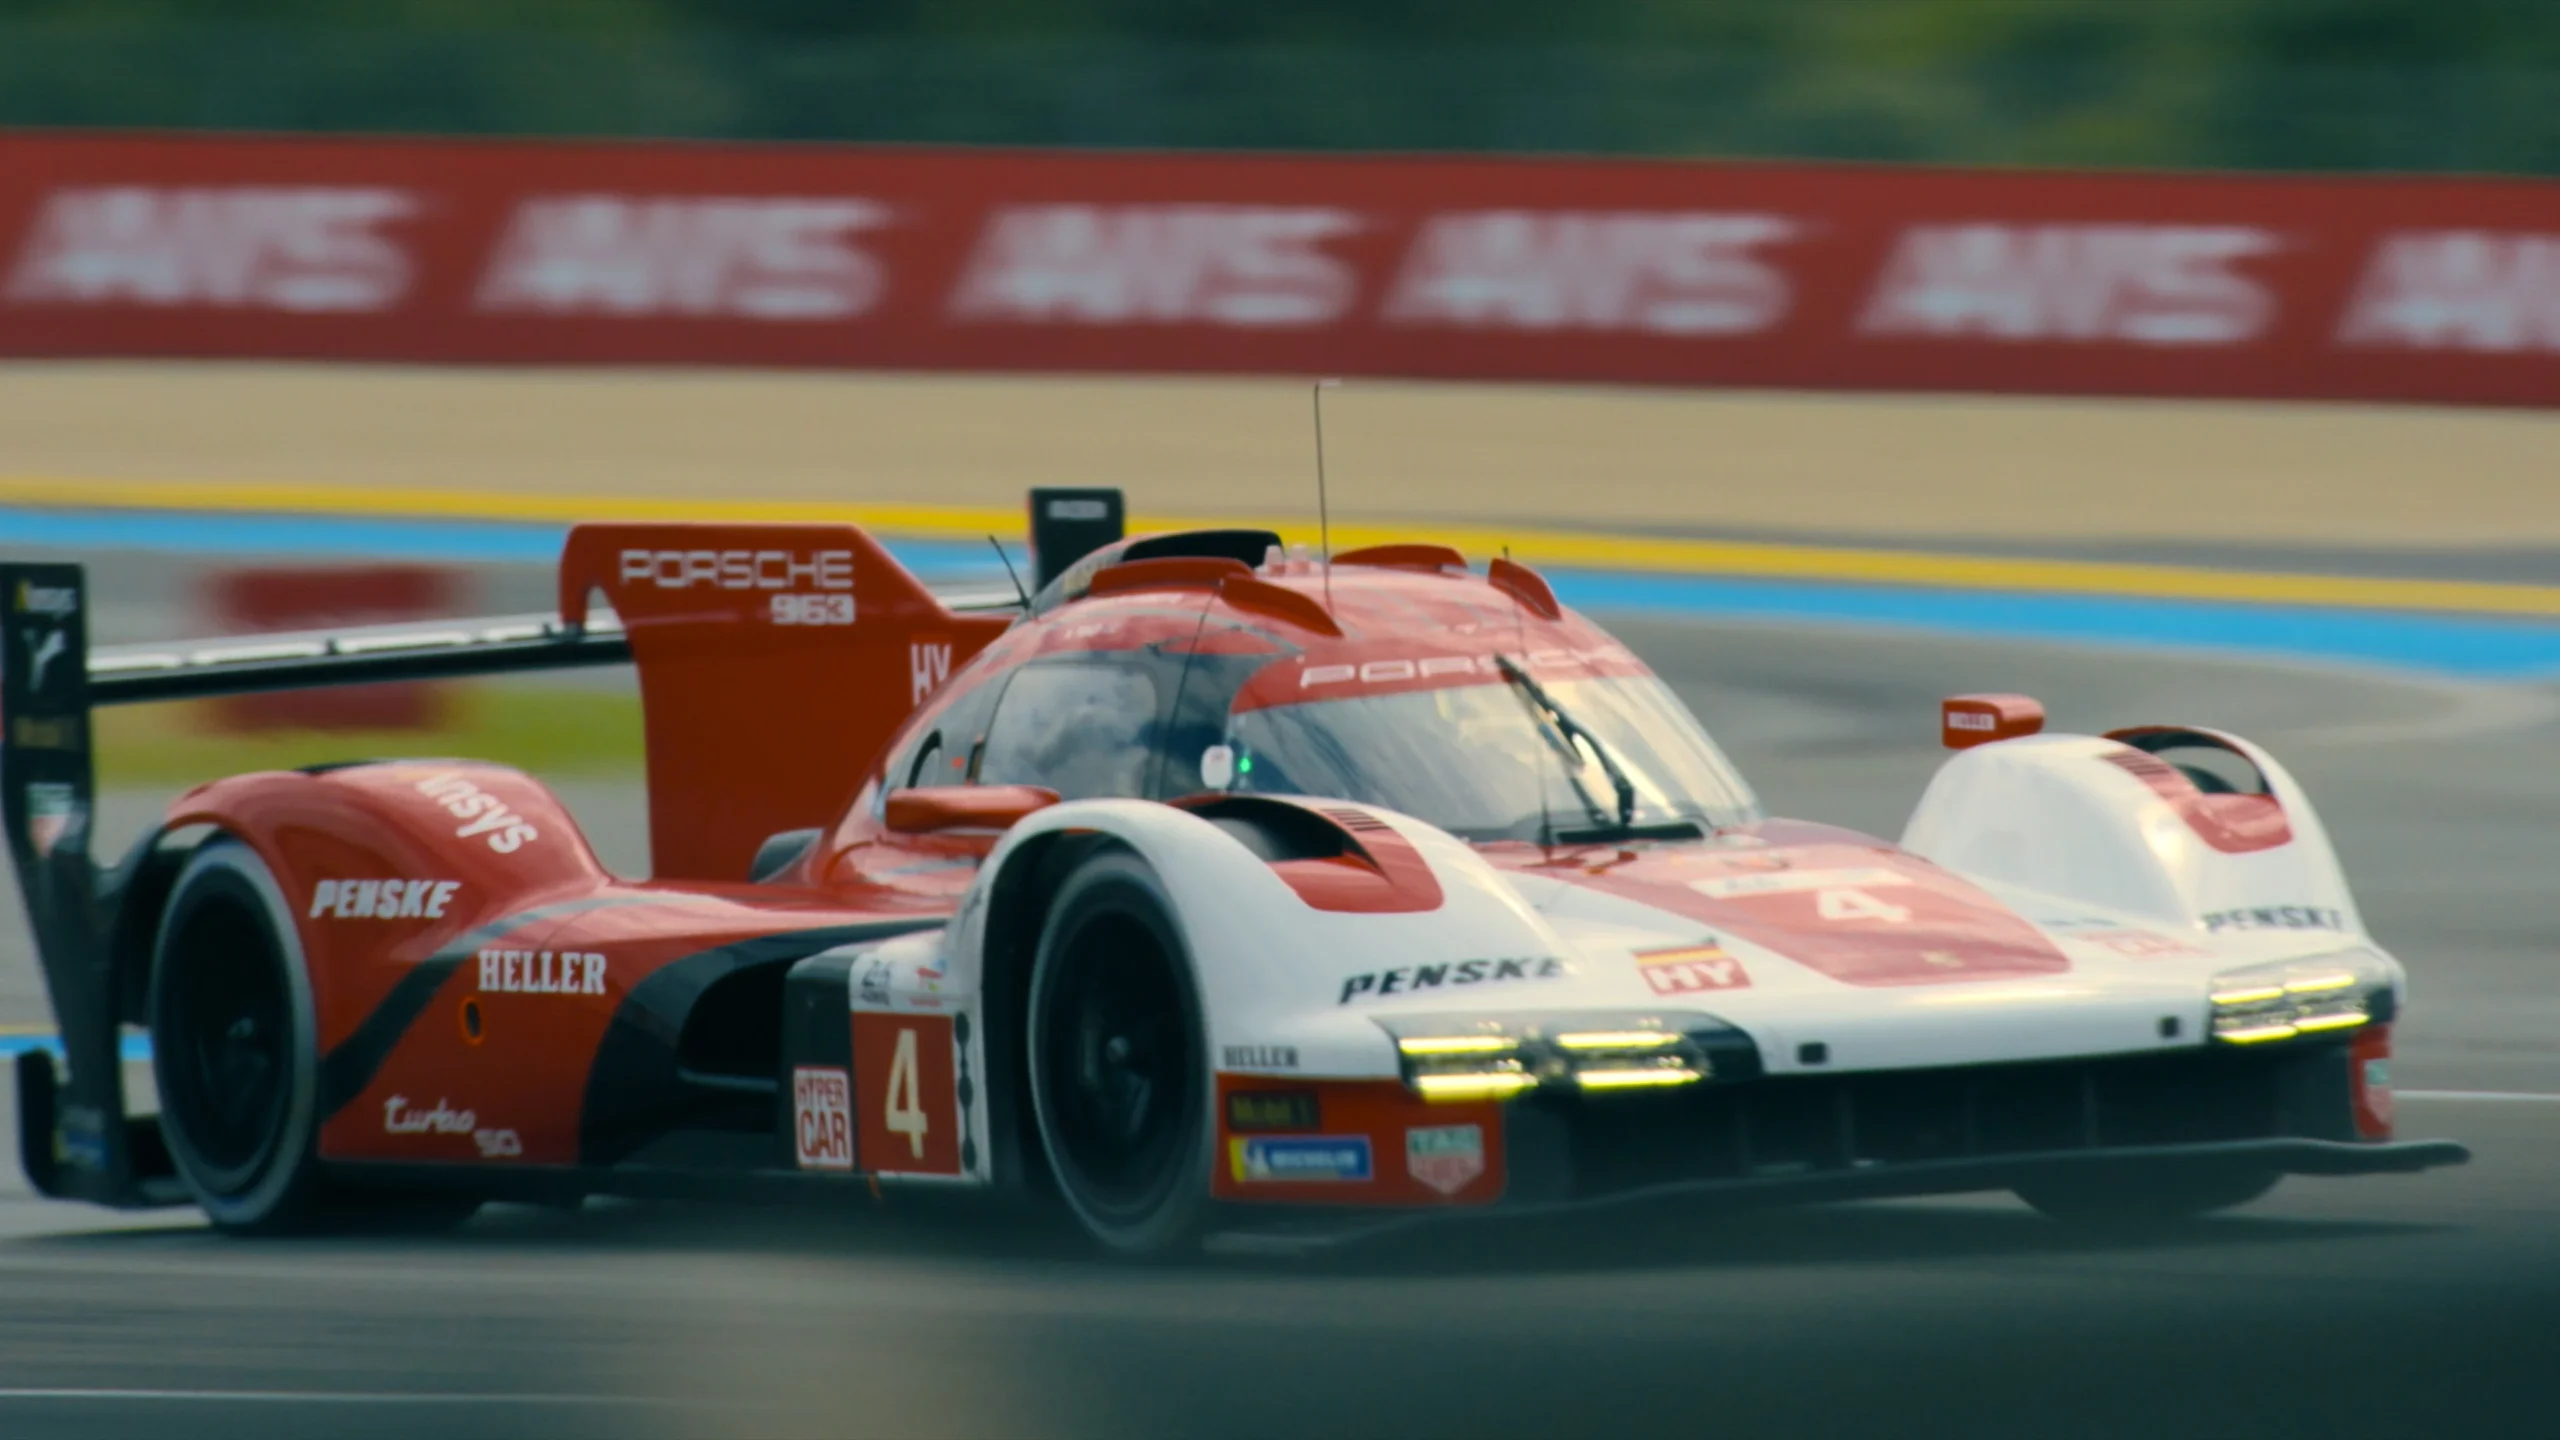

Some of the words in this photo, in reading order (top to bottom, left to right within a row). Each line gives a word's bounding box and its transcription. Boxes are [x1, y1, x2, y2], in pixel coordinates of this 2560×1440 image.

[620, 550, 854, 588] PORSCHE
[771, 594, 855, 625] 963
[911, 643, 951, 705] HY
[310, 880, 460, 918] PENSKE
[1817, 889, 1909, 923] 4
[478, 951, 605, 994] HELLER
[1339, 957, 1565, 1005] PENSKE
[1645, 961, 1738, 991] HY
[1223, 1045, 1299, 1067] HELLER
[798, 1078, 844, 1106] HYPER
[885, 1028, 928, 1159] 4
[801, 1110, 848, 1158] CAR
